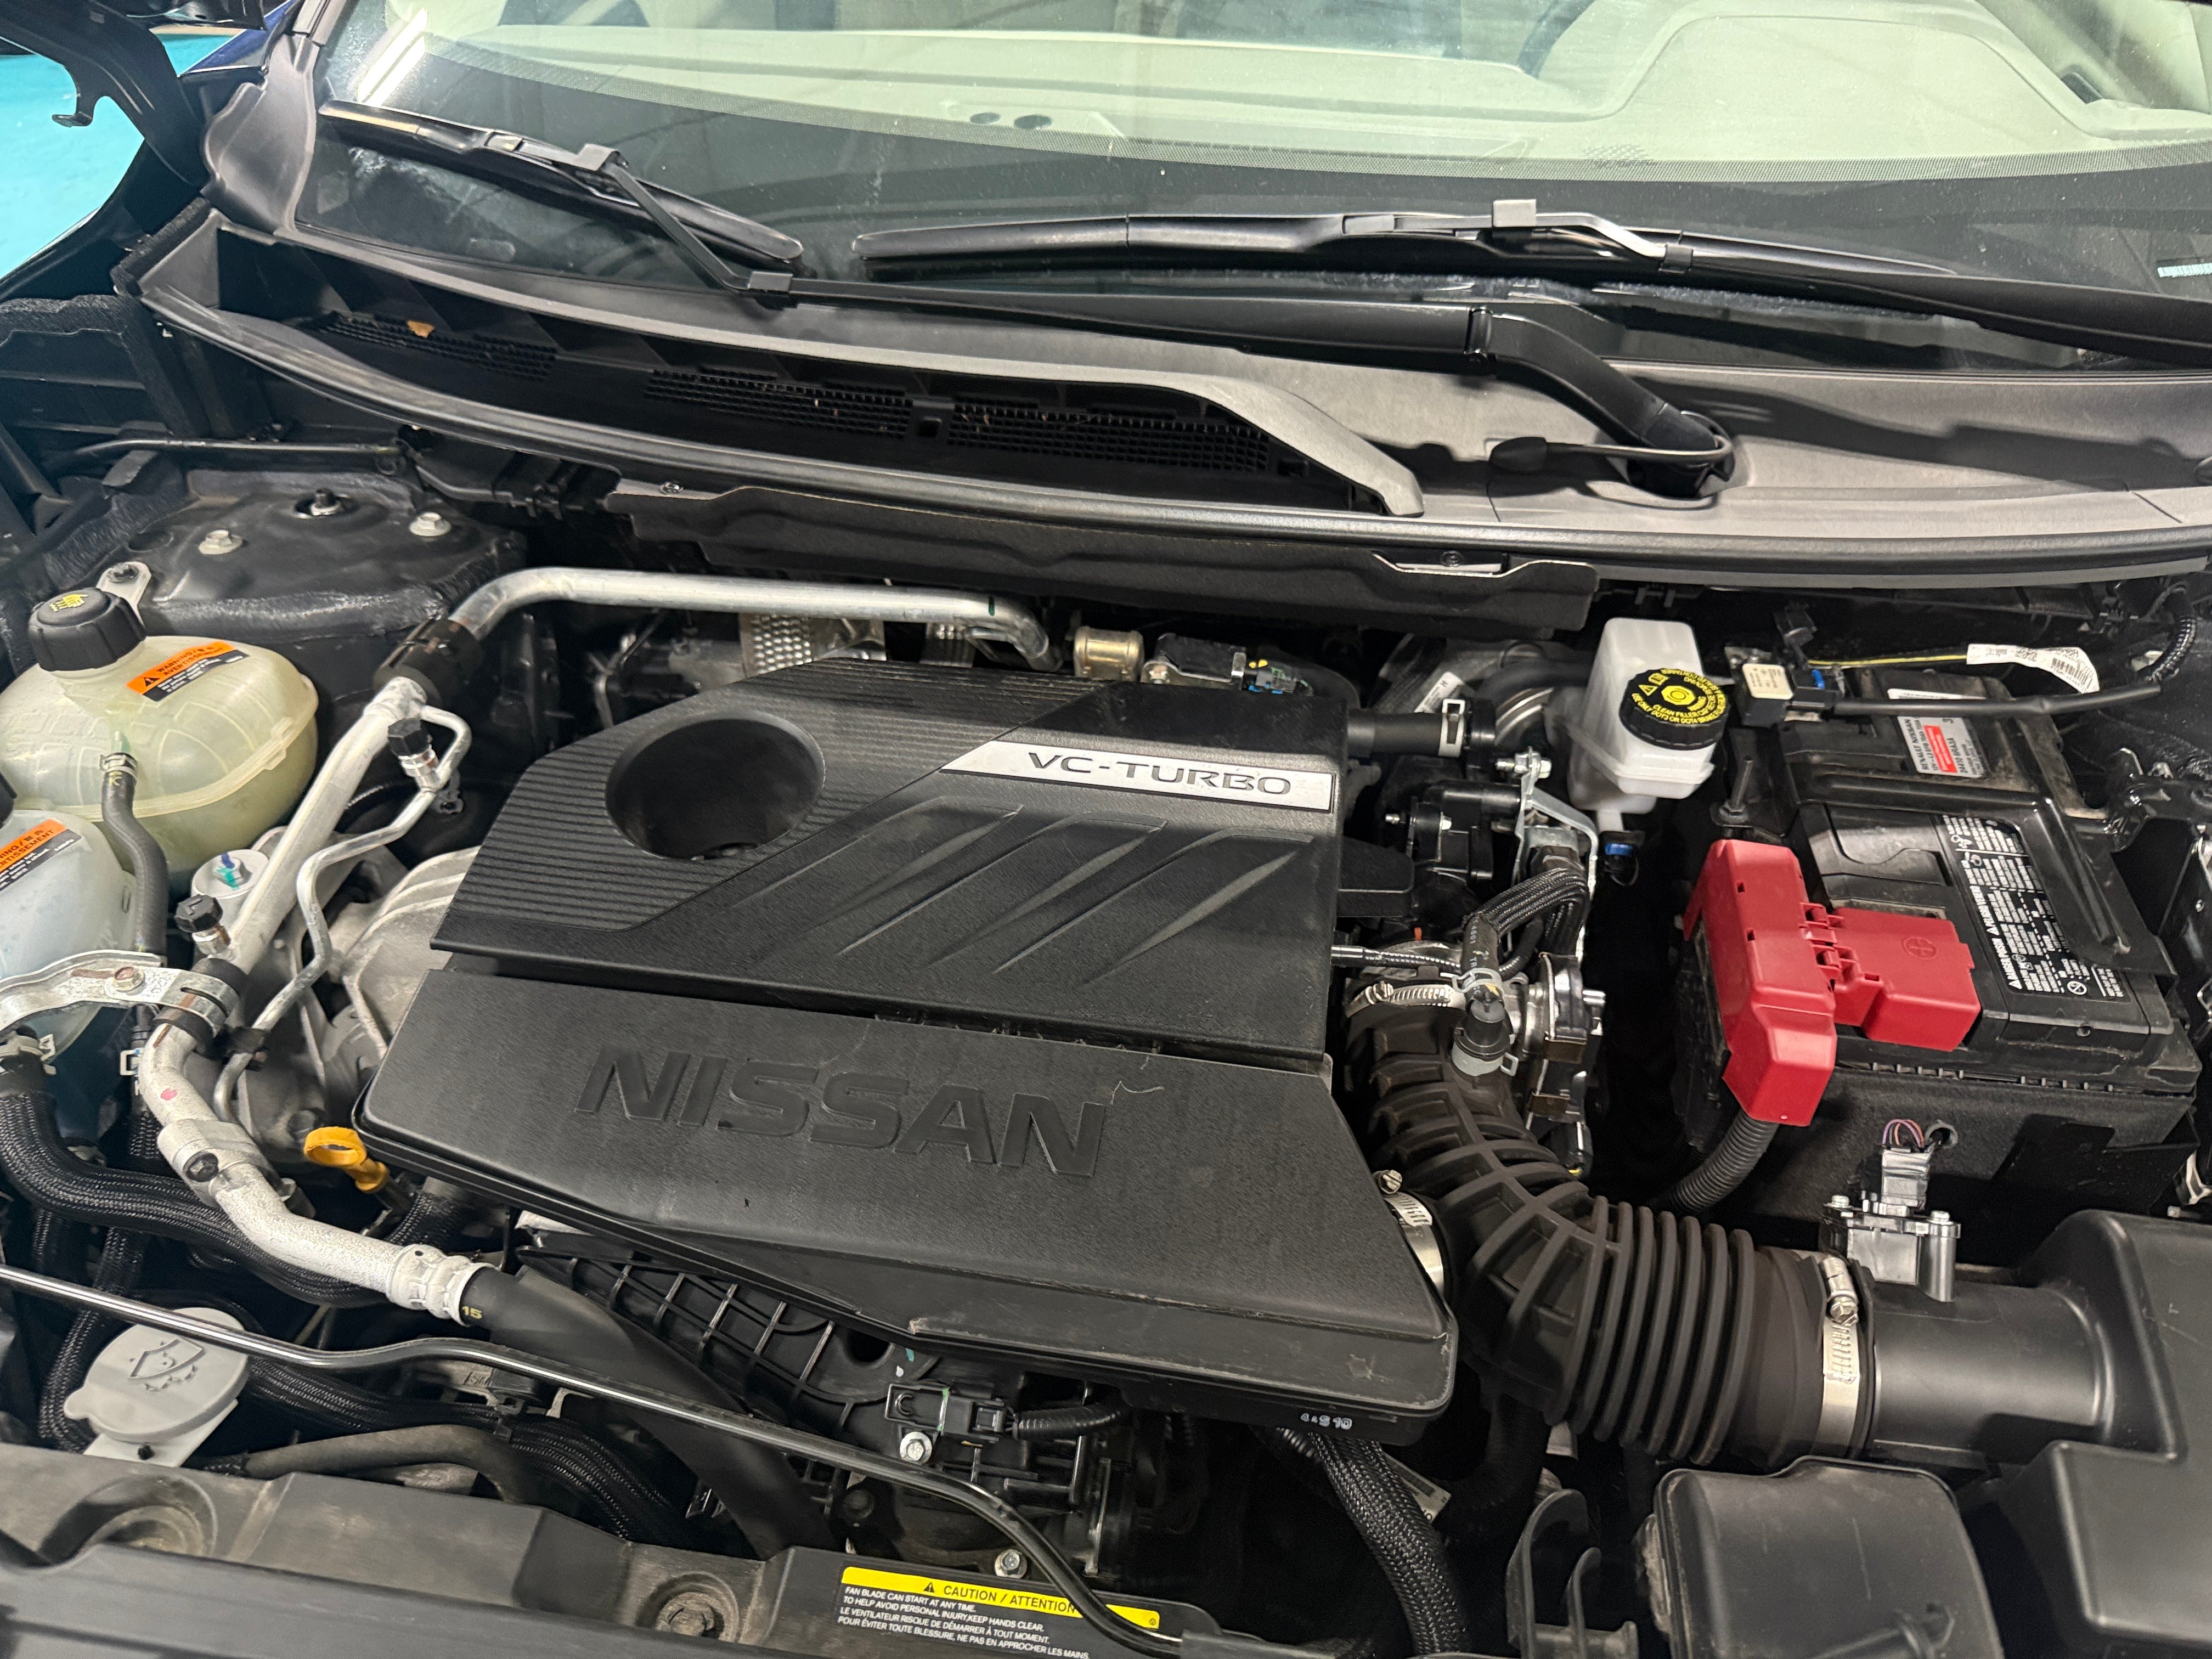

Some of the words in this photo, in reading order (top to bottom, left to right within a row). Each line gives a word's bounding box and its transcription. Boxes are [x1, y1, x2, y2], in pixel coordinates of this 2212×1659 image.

[1028, 752, 1291, 795] VC-TURBO
[574, 1047, 1107, 1177] NISSAN
[462, 1306, 482, 1319] 15
[845, 1586, 860, 1596] FAN
[861, 1588, 886, 1599] BLADE
[887, 1593, 905, 1601] CAN
[905, 1595, 929, 1605] START
[929, 1598, 940, 1607] AT
[940, 1600, 958, 1610] ANY
[944, 1585, 997, 1602] CAUTION
[843, 1595, 854, 1604] TO
[854, 1598, 875, 1607] HELP
[875, 1600, 900, 1611] AVOID
[900, 1604, 940, 1617] PERSONAL
[989, 1617, 1016, 1628] HANDS
[851, 1608, 900, 1622] VENTILATEUR
[900, 1615, 929, 1627] RISQUE
[930, 1620, 941, 1628] DE
[943, 1620, 985, 1635] DÉMARRER
[994, 1629, 1014, 1639] TOUT
[1014, 1633, 1050, 1645] MOMENT.
[838, 1616, 860, 1626] POUR
[861, 1618, 888, 1630] ÉVITER
[888, 1623, 913, 1633] TOUTE
[957, 1634, 968, 1643] NE
[969, 1635, 985, 1645] PAS
[986, 1638, 998, 1646] EN
[997, 1640, 1047, 1654] APPROCHER
[1047, 1647, 1063, 1656] LES
[1063, 1650, 1090, 1659] MAINS.
